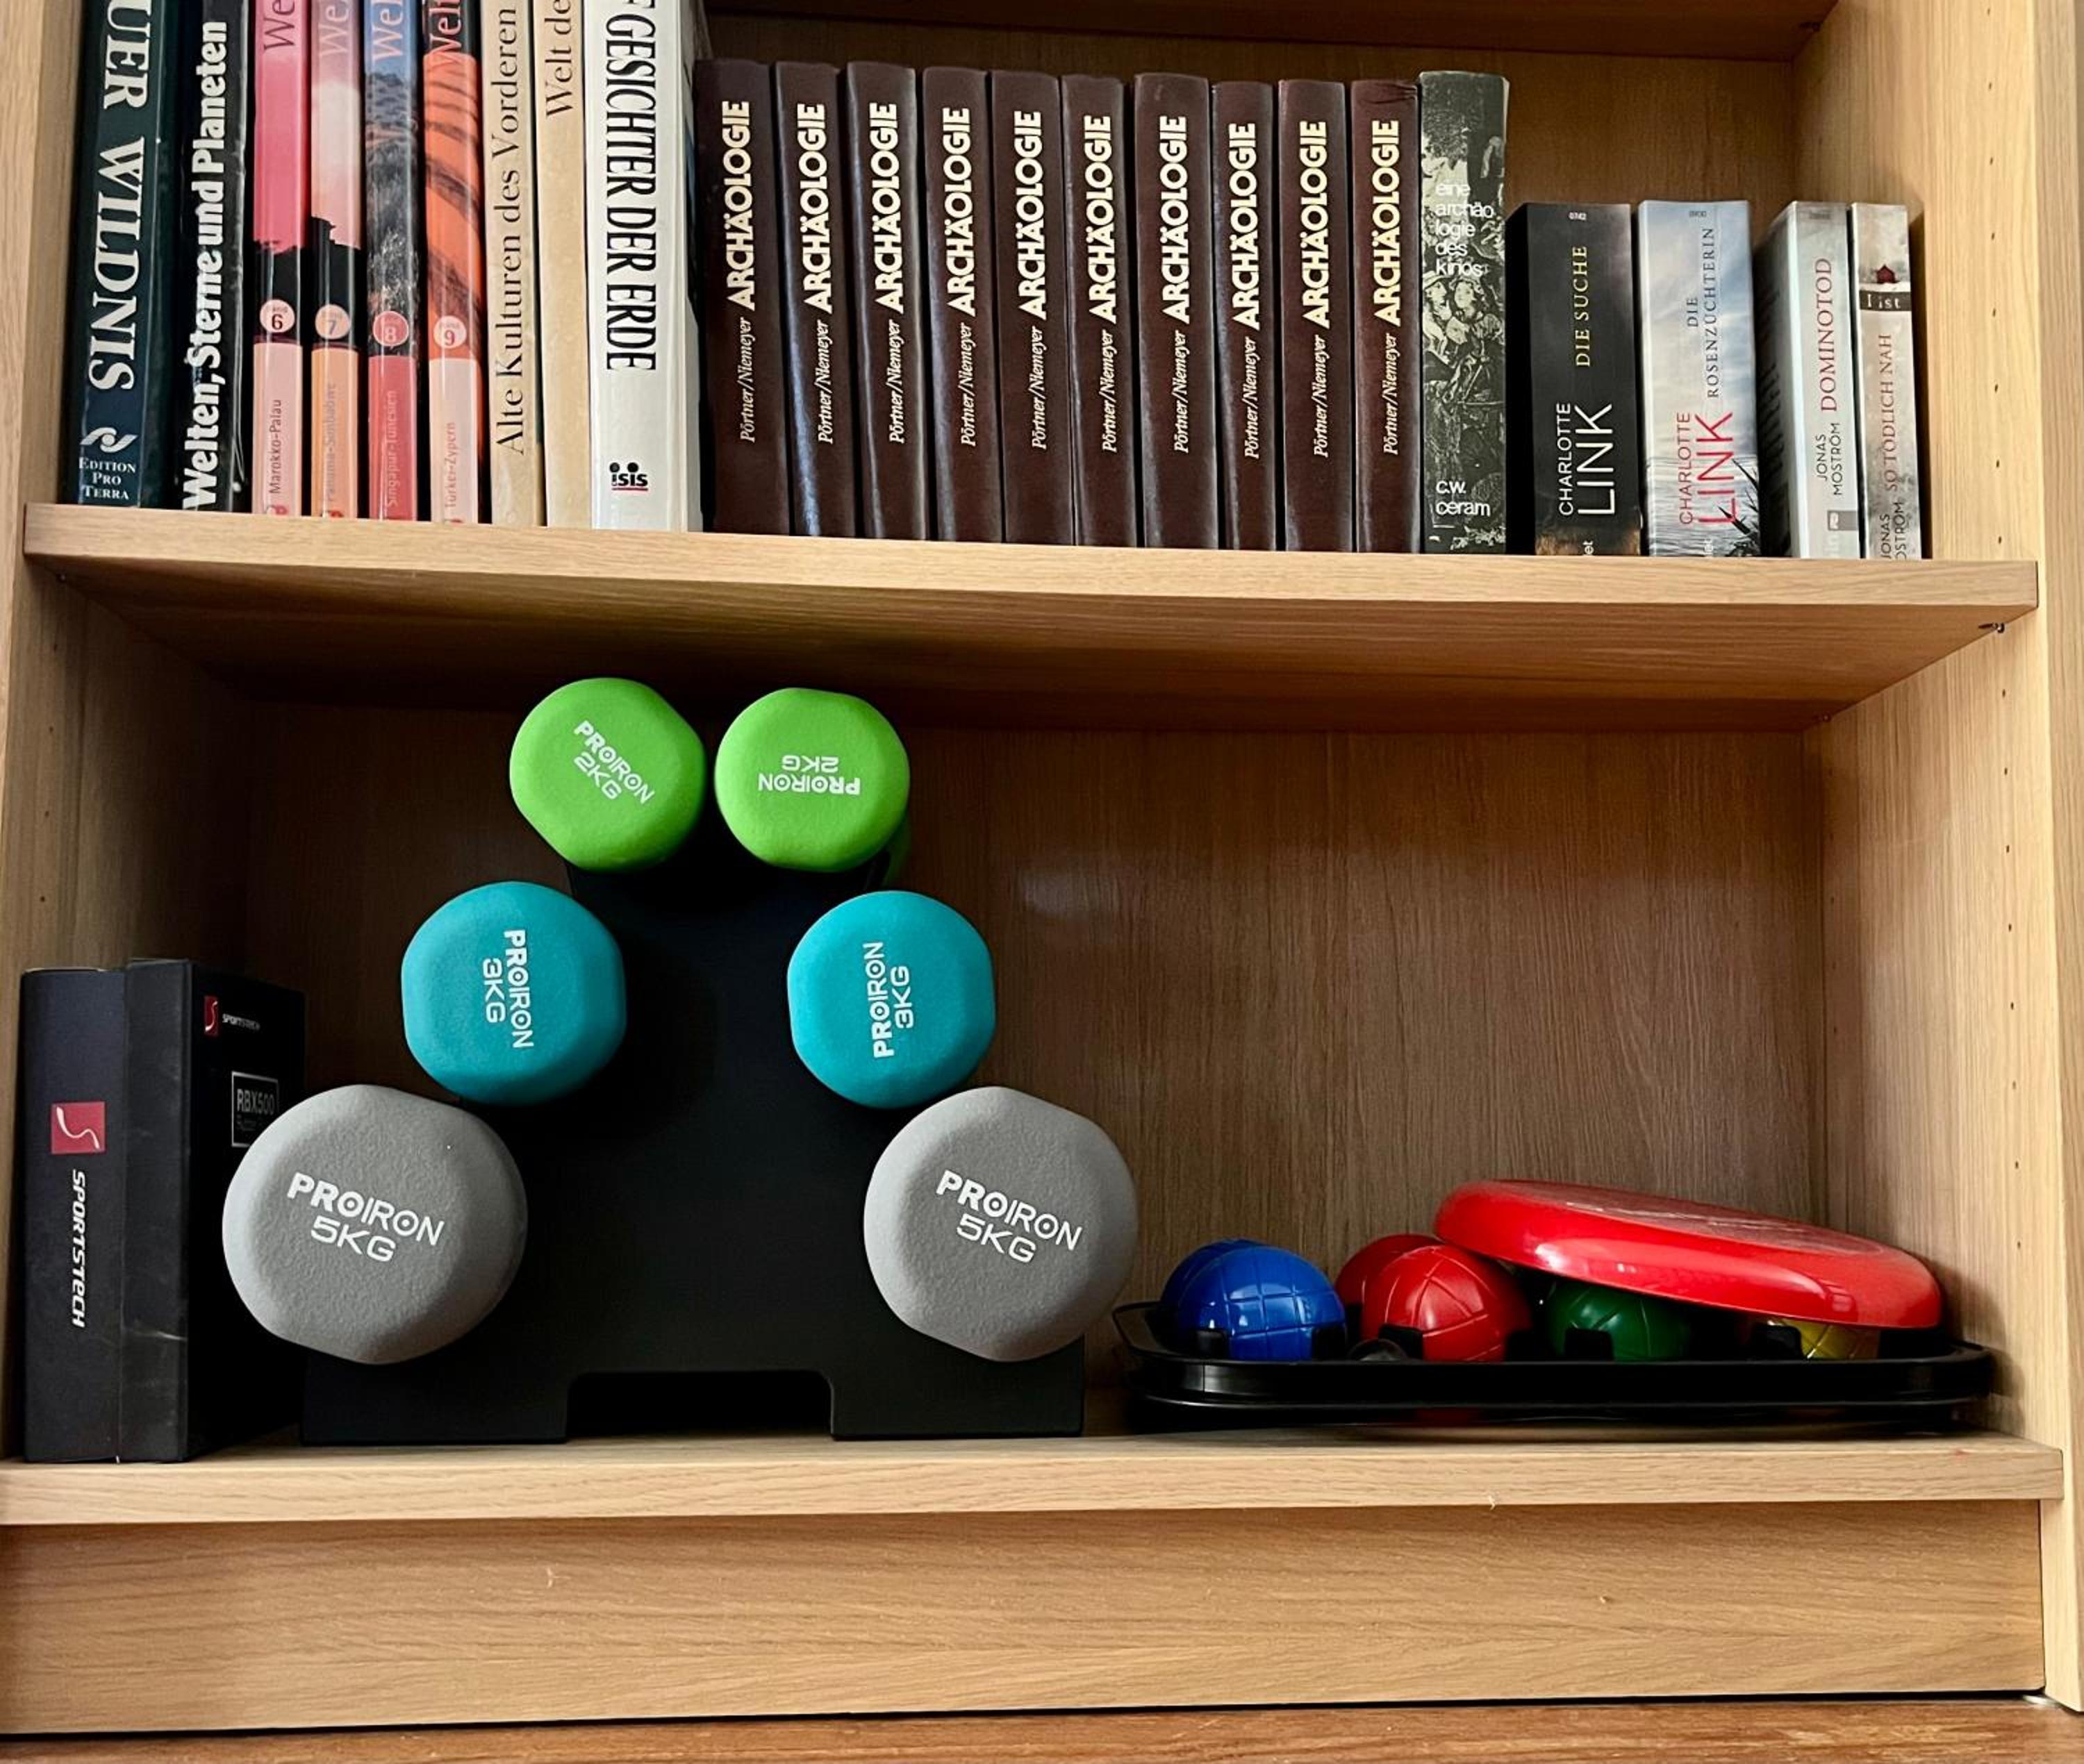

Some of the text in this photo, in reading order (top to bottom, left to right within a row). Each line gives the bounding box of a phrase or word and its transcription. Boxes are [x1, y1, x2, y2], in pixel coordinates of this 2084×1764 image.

[192, 22, 226, 173] Planeten
[545, 44, 573, 117] Welt
[606, 14, 656, 198] GESICHTER
[192, 181, 224, 248] und
[490, 8, 524, 456] Alte Kulturen des Vorderen
[607, 207, 656, 274] DER
[722, 101, 754, 310] ARCHÄOLOGIE
[797, 104, 832, 313] ARCHÄOLOGIE
[870, 103, 903, 313] ARCHÄOLOGIE
[943, 108, 975, 317] ARCHÄOLOGIE
[1014, 111, 1046, 319] ARCHÄOLOGIE
[1084, 116, 1116, 324] ARCHÄOLOGIE
[1160, 116, 1189, 324] ARCHÄOLOGIE
[1229, 124, 1259, 330] ARCHÄOLOGIE
[1300, 122, 1329, 328] ARCHÄOLOGIE
[1372, 121, 1400, 326] ARCHÄOLOGIE
[1436, 219, 1475, 241] logie
[88, 136, 144, 390] WILDNIS
[1435, 240, 1468, 256] des
[186, 250, 222, 369] Sterne
[272, 313, 283, 331] 6
[328, 320, 338, 335] 7
[383, 326, 397, 342] 8
[444, 330, 455, 346] 9
[607, 284, 656, 370] ERDE
[1572, 246, 1590, 367] DIE SUCHE
[1687, 297, 1698, 328] DIE
[1814, 258, 1837, 413] DOMINOTOD
[1878, 335, 1893, 374] NAH
[79, 456, 135, 474] EDITION
[92, 473, 122, 486] PRO
[270, 399, 282, 494] Marokko-Palau
[609, 462, 648, 486] isis
[1556, 403, 1574, 516] CHARLOTTE
[1574, 403, 1615, 515] LINK
[1676, 413, 1693, 524] CHARLOTTE
[1694, 412, 1737, 524] LINK
[1815, 434, 1828, 481] JONAS
[1885, 469, 1898, 492] SO
[82, 485, 129, 501] TERRA
[1436, 501, 1491, 517] ceram
[574, 720, 654, 804] PROIRON
[574, 752, 622, 800] 2KG
[758, 772, 861, 795] PROIRON
[782, 754, 839, 772] 2KG
[482, 958, 506, 1024] 3KG
[504, 929, 534, 1049] PROIRON
[863, 941, 895, 1058] PROIRON
[890, 965, 914, 1029] 3KG
[236, 1088, 275, 1117] RBX500
[287, 1172, 445, 1247] PROIRON
[311, 1217, 396, 1263] 5KG
[936, 1170, 1082, 1251] PROIRON
[957, 1213, 1036, 1264] 5KG
